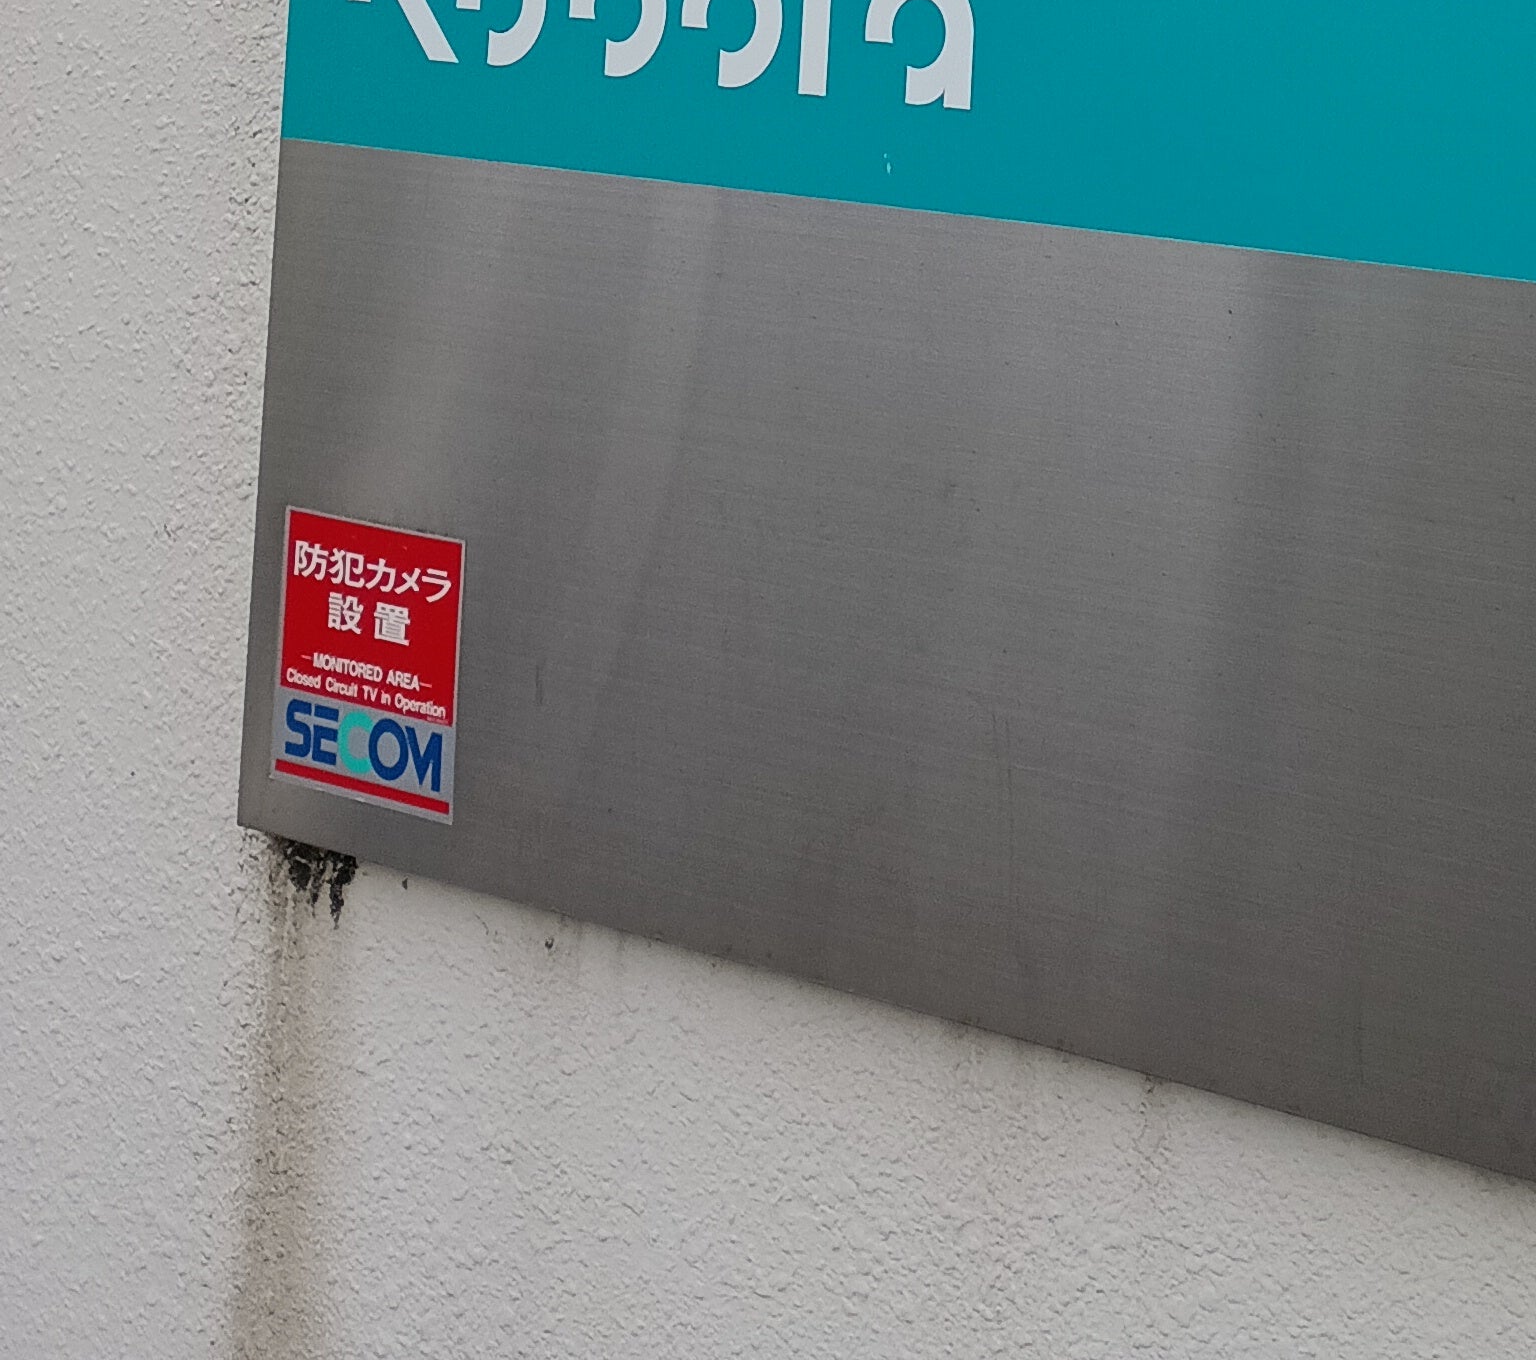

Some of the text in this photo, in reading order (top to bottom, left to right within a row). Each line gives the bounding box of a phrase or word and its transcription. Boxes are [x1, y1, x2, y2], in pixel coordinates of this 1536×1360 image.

[294, 540, 452, 603] 防犯カメラ
[328, 591, 410, 646] 設置
[286, 668, 446, 719] Closed Circuit TV in Operation
[285, 698, 443, 793] SECOM
